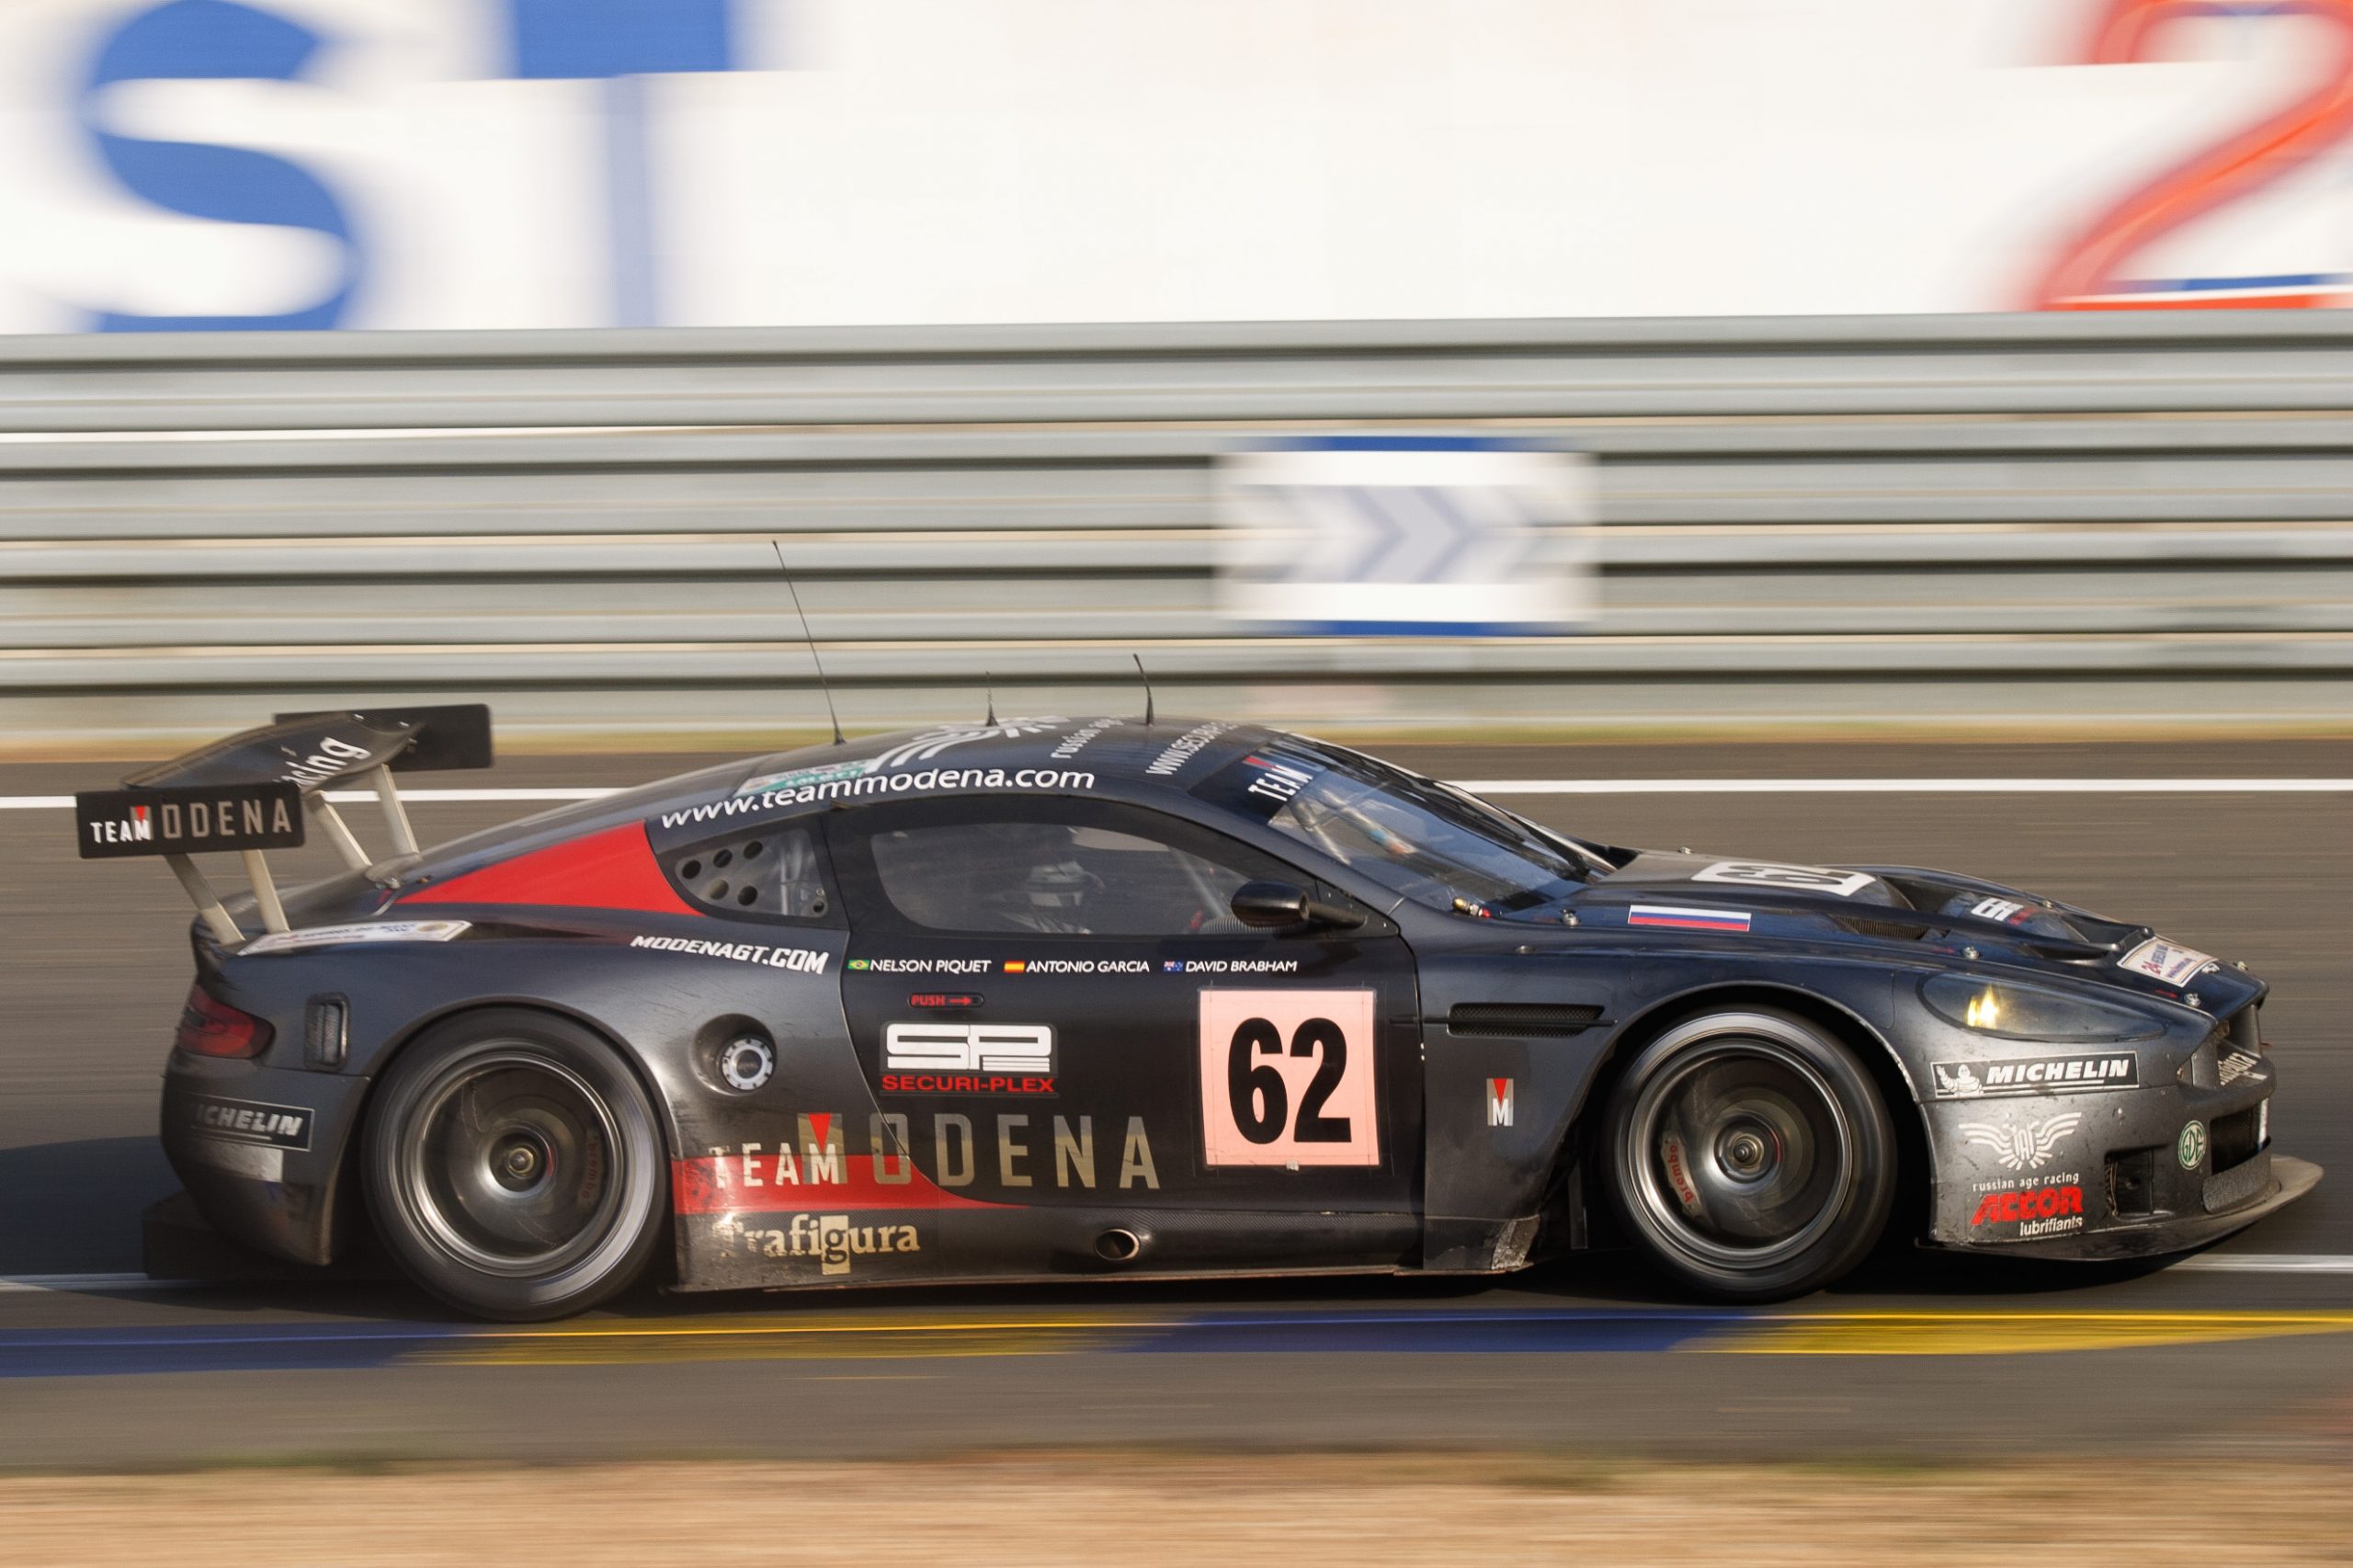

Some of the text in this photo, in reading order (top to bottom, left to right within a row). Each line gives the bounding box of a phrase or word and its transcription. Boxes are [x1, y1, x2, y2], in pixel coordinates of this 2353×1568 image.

[1248, 764, 1313, 802] TEAM
[661, 767, 1096, 829] www.teammodena.com
[90, 818, 152, 843] TEAM
[630, 935, 830, 975] MODENAGT.COM
[870, 959, 992, 974] NELSON PIQUET
[1026, 960, 1150, 973] ANTONIO GARCIA
[1185, 960, 1298, 973] DAVID BRABHAM
[910, 994, 946, 1007] PUSH
[881, 1074, 1056, 1094] SECURI-PLEX
[1228, 1017, 1352, 1144] 62
[1985, 1059, 2130, 1085] MICHELIN
[194, 1105, 304, 1138] ICHELIN
[1489, 1090, 1513, 1127] M
[709, 1142, 841, 1189] TEAM
[1667, 1144, 1694, 1203] brembo
[1972, 1172, 2080, 1192] russian age racing
[2019, 1215, 2084, 1236] lubrifiants
